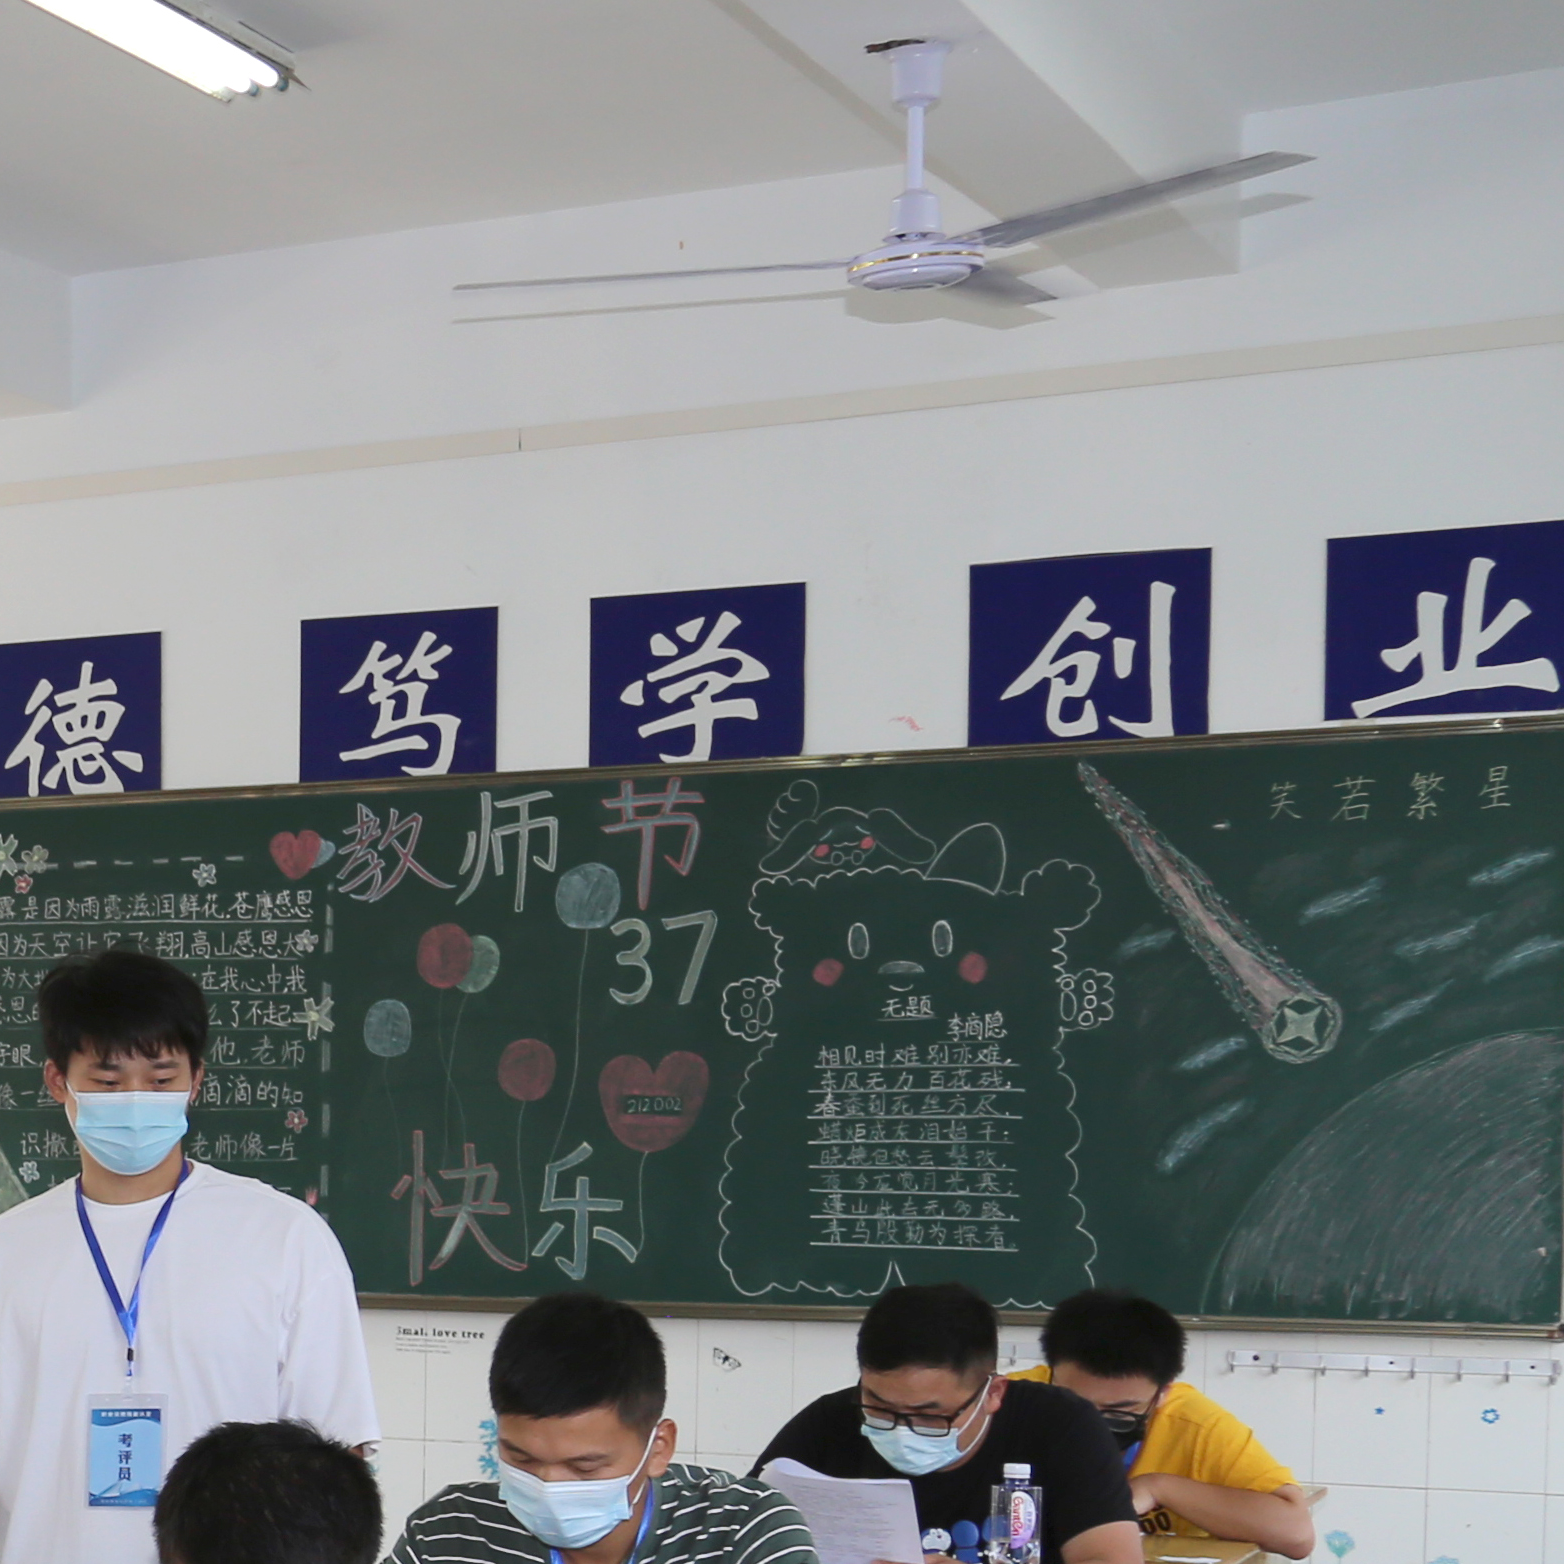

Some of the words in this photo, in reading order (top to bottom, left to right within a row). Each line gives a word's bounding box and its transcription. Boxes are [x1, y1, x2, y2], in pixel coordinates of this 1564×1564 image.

[336, 776, 705, 912] 教师节
[608, 909, 719, 1006] 37
[881, 994, 935, 1018] 无题
[946, 1010, 1008, 1042] 李商隐
[390, 1129, 639, 1287] 快乐
[432, 1327, 458, 1338] love
